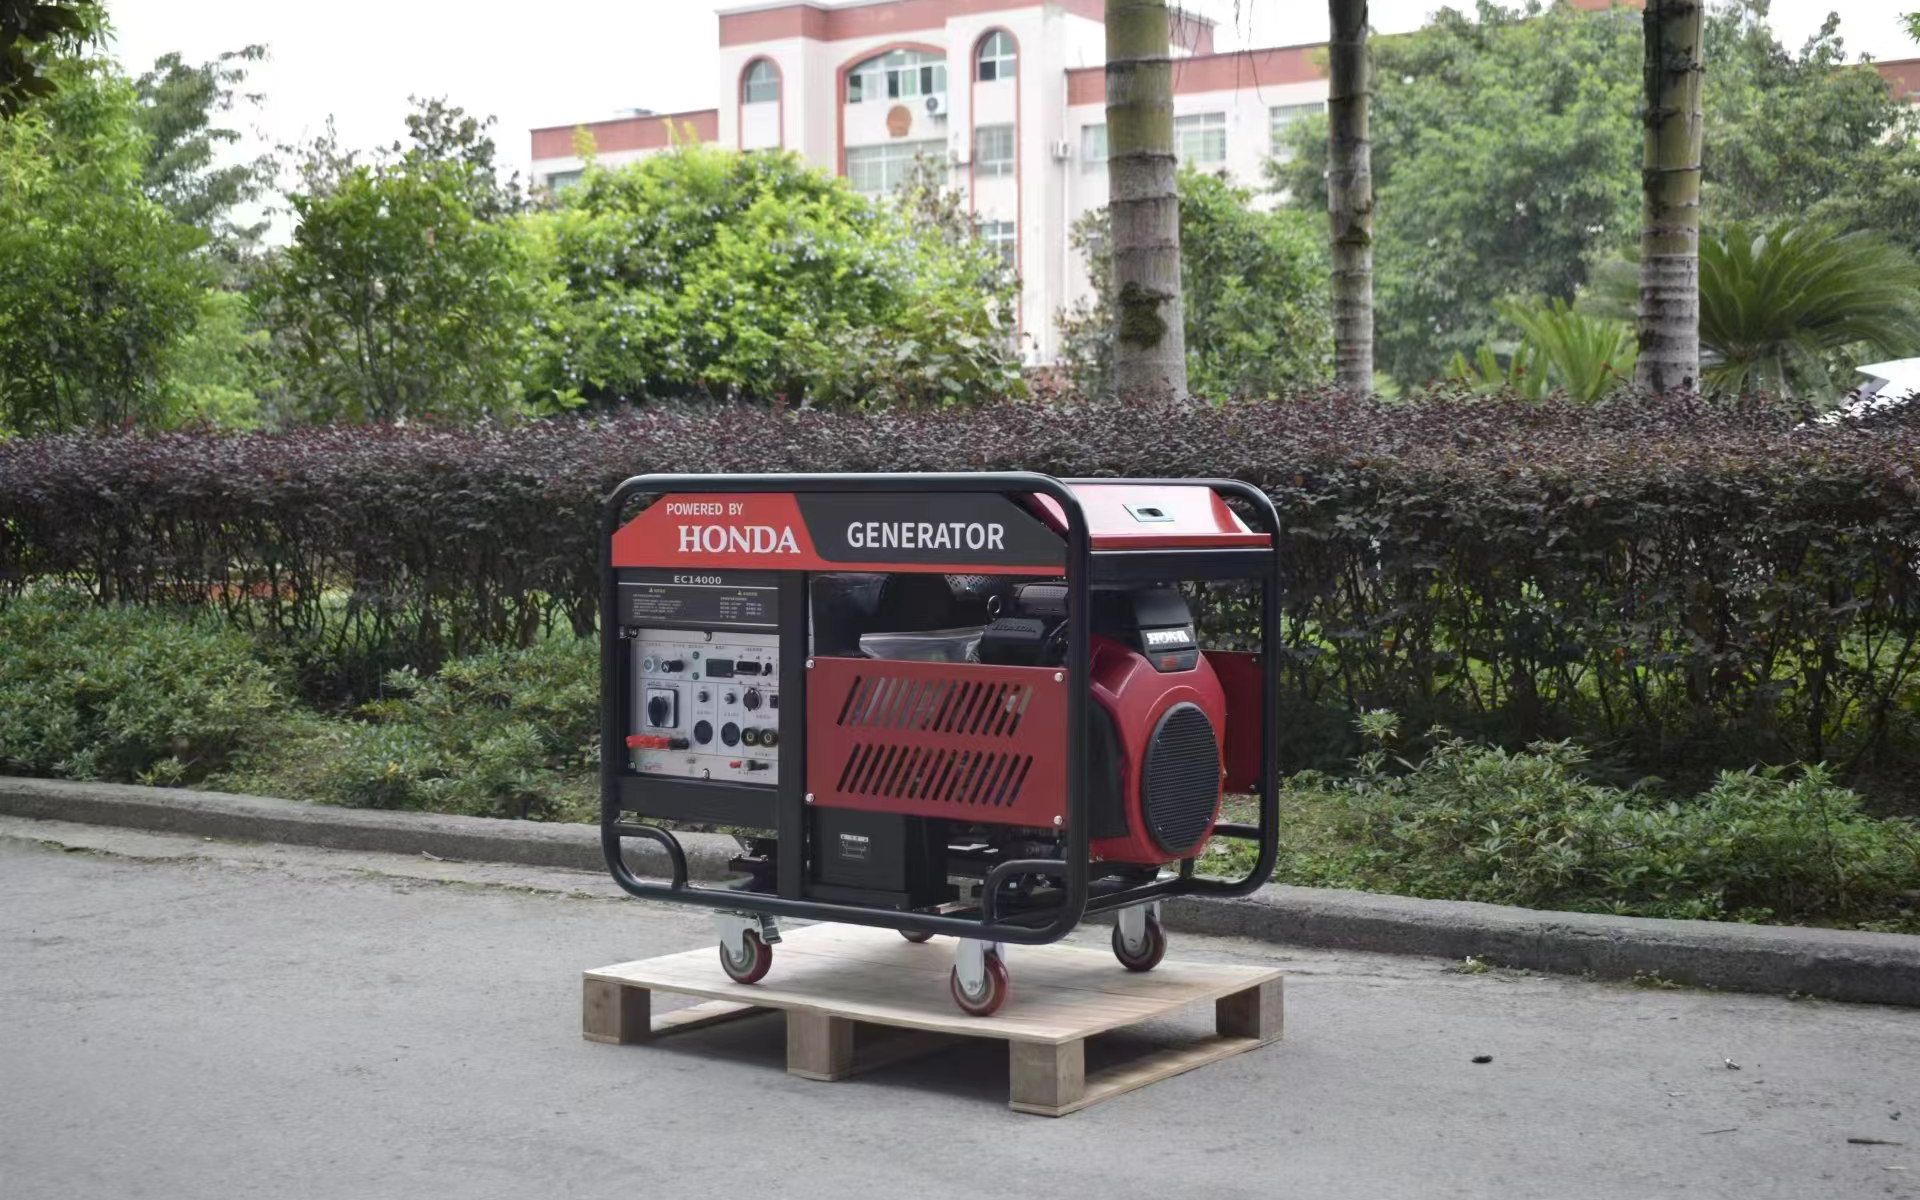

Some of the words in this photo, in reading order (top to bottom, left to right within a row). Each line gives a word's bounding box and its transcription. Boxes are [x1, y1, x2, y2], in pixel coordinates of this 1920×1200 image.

[666, 503, 723, 515] POWERED
[728, 503, 743, 515] BY
[678, 525, 801, 554] HONDA
[847, 521, 1005, 550] GENERATOR
[673, 575, 722, 585] EC14000
